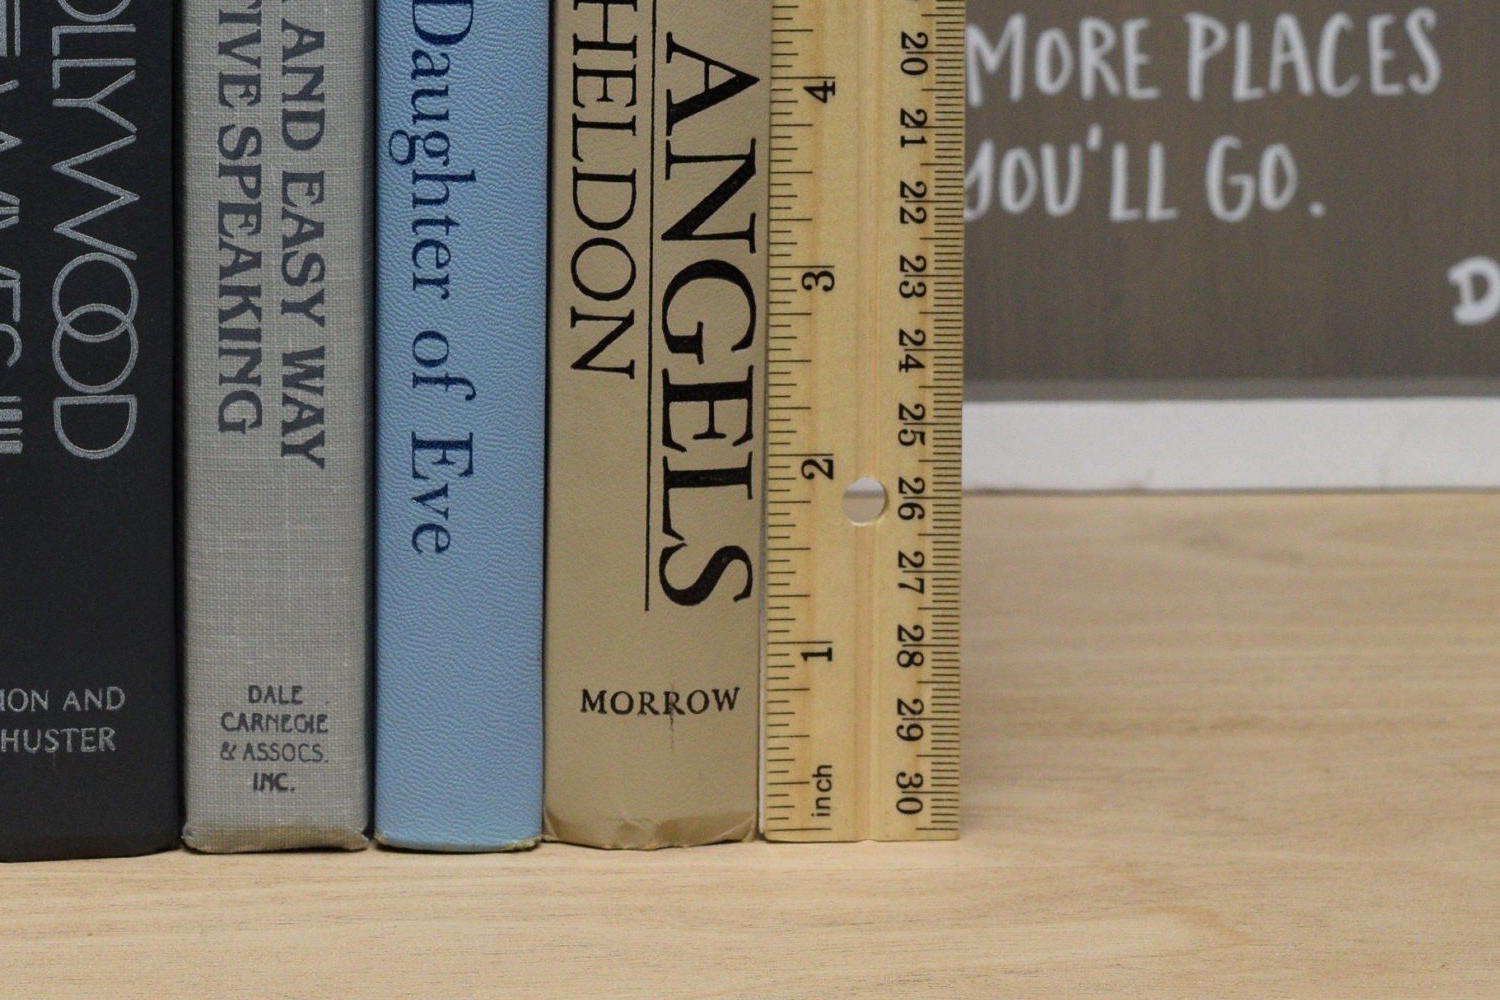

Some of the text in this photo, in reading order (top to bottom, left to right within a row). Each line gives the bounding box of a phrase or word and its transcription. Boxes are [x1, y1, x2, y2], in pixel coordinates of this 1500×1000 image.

[901, 31, 928, 75] 20
[966, 8, 1441, 107] MORE PLACES
[281, 17, 326, 152] AND
[803, 81, 836, 103] 4
[901, 108, 928, 148] 21
[1206, 136, 1324, 222] GO.
[900, 181, 927, 225] 22
[280, 170, 326, 328] EASY
[217, 123, 263, 435] SPEAKING
[802, 270, 835, 292] 3
[900, 255, 927, 298] 23
[658, 31, 760, 607] ANGELS
[411, 330, 477, 402] of
[899, 329, 926, 372] 24
[280, 345, 326, 470] WAY
[899, 404, 925, 447] 25
[801, 457, 833, 480] 2
[411, 430, 474, 555] Eve
[898, 477, 925, 520] 26
[898, 551, 924, 594] 27
[801, 646, 833, 662] 1
[897, 625, 924, 668] 28
[62, 685, 126, 712] AND
[247, 684, 304, 705] DALE
[580, 686, 741, 716] MORROW
[220, 711, 329, 734] CARNEGIE
[897, 698, 924, 741] 29
[219, 740, 329, 763] & ASSOCS.
[252, 772, 296, 793] INC.
[811, 764, 832, 816] inch
[896, 773, 923, 815] 30
